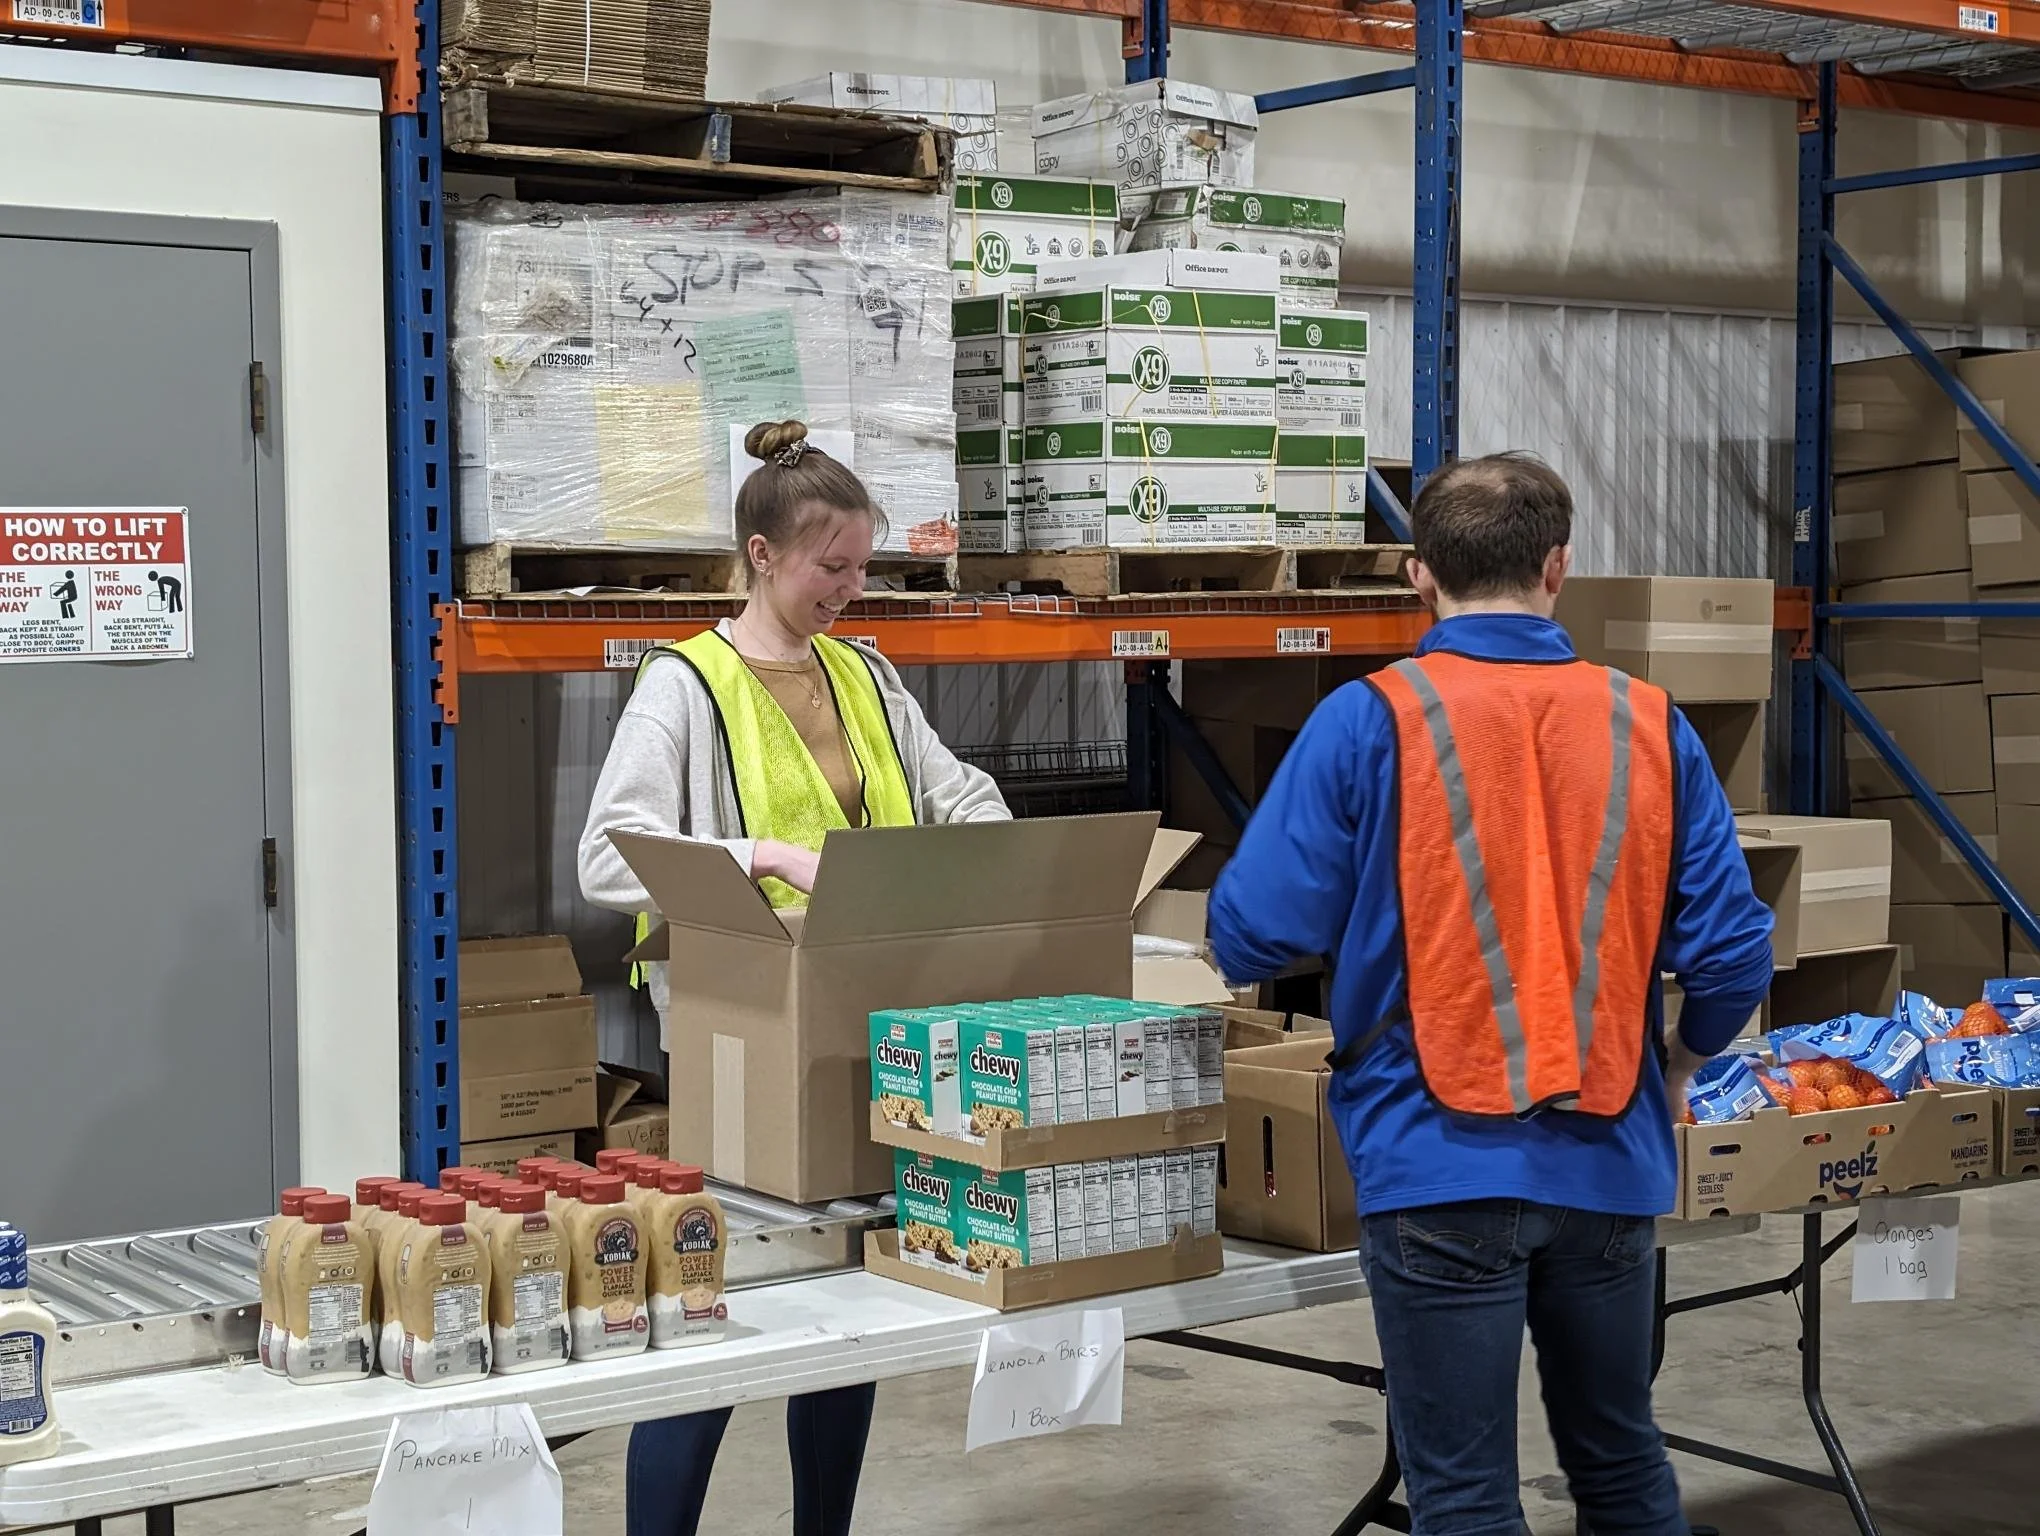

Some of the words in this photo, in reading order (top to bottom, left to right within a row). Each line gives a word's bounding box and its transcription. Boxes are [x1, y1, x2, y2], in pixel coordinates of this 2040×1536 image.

[1039, 156, 1060, 168] copy
[1185, 264, 1207, 273] Office
[4, 518, 65, 537] HOW
[72, 517, 107, 537] TO
[115, 517, 168, 537] LIFT
[12, 541, 163, 562] CORRECTLY
[0, 571, 26, 583] THE
[94, 570, 121, 582] THE
[0, 586, 43, 598] RIGHT
[94, 584, 143, 597] WRONG
[0, 601, 29, 613] WAY
[94, 599, 123, 611] WAY
[23, 639, 33, 647] TO
[48, 645, 81, 653] CORNERS
[130, 643, 137, 651] &
[137, 643, 169, 651] ABDOMEN
[1155, 636, 1164, 650] A
[877, 1038, 922, 1077] chewy
[934, 1051, 958, 1061] chewy
[1120, 1051, 1144, 1061] chewy
[970, 1045, 1020, 1086] chewy
[878, 1072, 907, 1084] CHOCOLATE
[907, 1078, 919, 1086] CHIP
[882, 1080, 901, 1091] PEANUT
[901, 1084, 920, 1096] BUTTER
[971, 1080, 1003, 1094] CHOCOLATE
[1003, 1087, 1018, 1096] CHIP
[526, 1099, 540, 1107] Case
[975, 1089, 997, 1101] PEANUT
[997, 1094, 1018, 1106] BUTTER
[1950, 1144, 1989, 1160] MANDARINS
[1819, 1151, 1879, 1188] peelz
[1697, 1173, 1715, 1184] SWEET
[1719, 1171, 1734, 1183] JUICY
[903, 1164, 951, 1206] chewy
[1697, 1183, 1725, 1196] SEEDLESS
[904, 1198, 935, 1213] CHOCOLATE
[934, 1206, 947, 1216] CHIP
[966, 1182, 1018, 1225] chewy
[908, 1207, 929, 1219] PEANUT
[928, 1213, 948, 1225] BUTTER
[966, 1216, 1000, 1232] CHOCOLATE
[1000, 1224, 1015, 1235] CHIP
[971, 1226, 994, 1238] PEANUT
[993, 1232, 1016, 1243] BUTTER
[1873, 1221, 1935, 1249] Oranges
[682, 1240, 711, 1252] KODIAK
[603, 1251, 632, 1264] KODIAK
[679, 1254, 716, 1265] POWER
[600, 1265, 635, 1277] POWER
[681, 1263, 714, 1272] CAKES
[1900, 1259, 1928, 1282] bag
[601, 1274, 635, 1285] CAKES
[681, 1278, 701, 1286] QUICK
[602, 1290, 622, 1298] QUICK
[987, 1354, 1046, 1373] RANOLA
[1054, 1340, 1099, 1361] BARS
